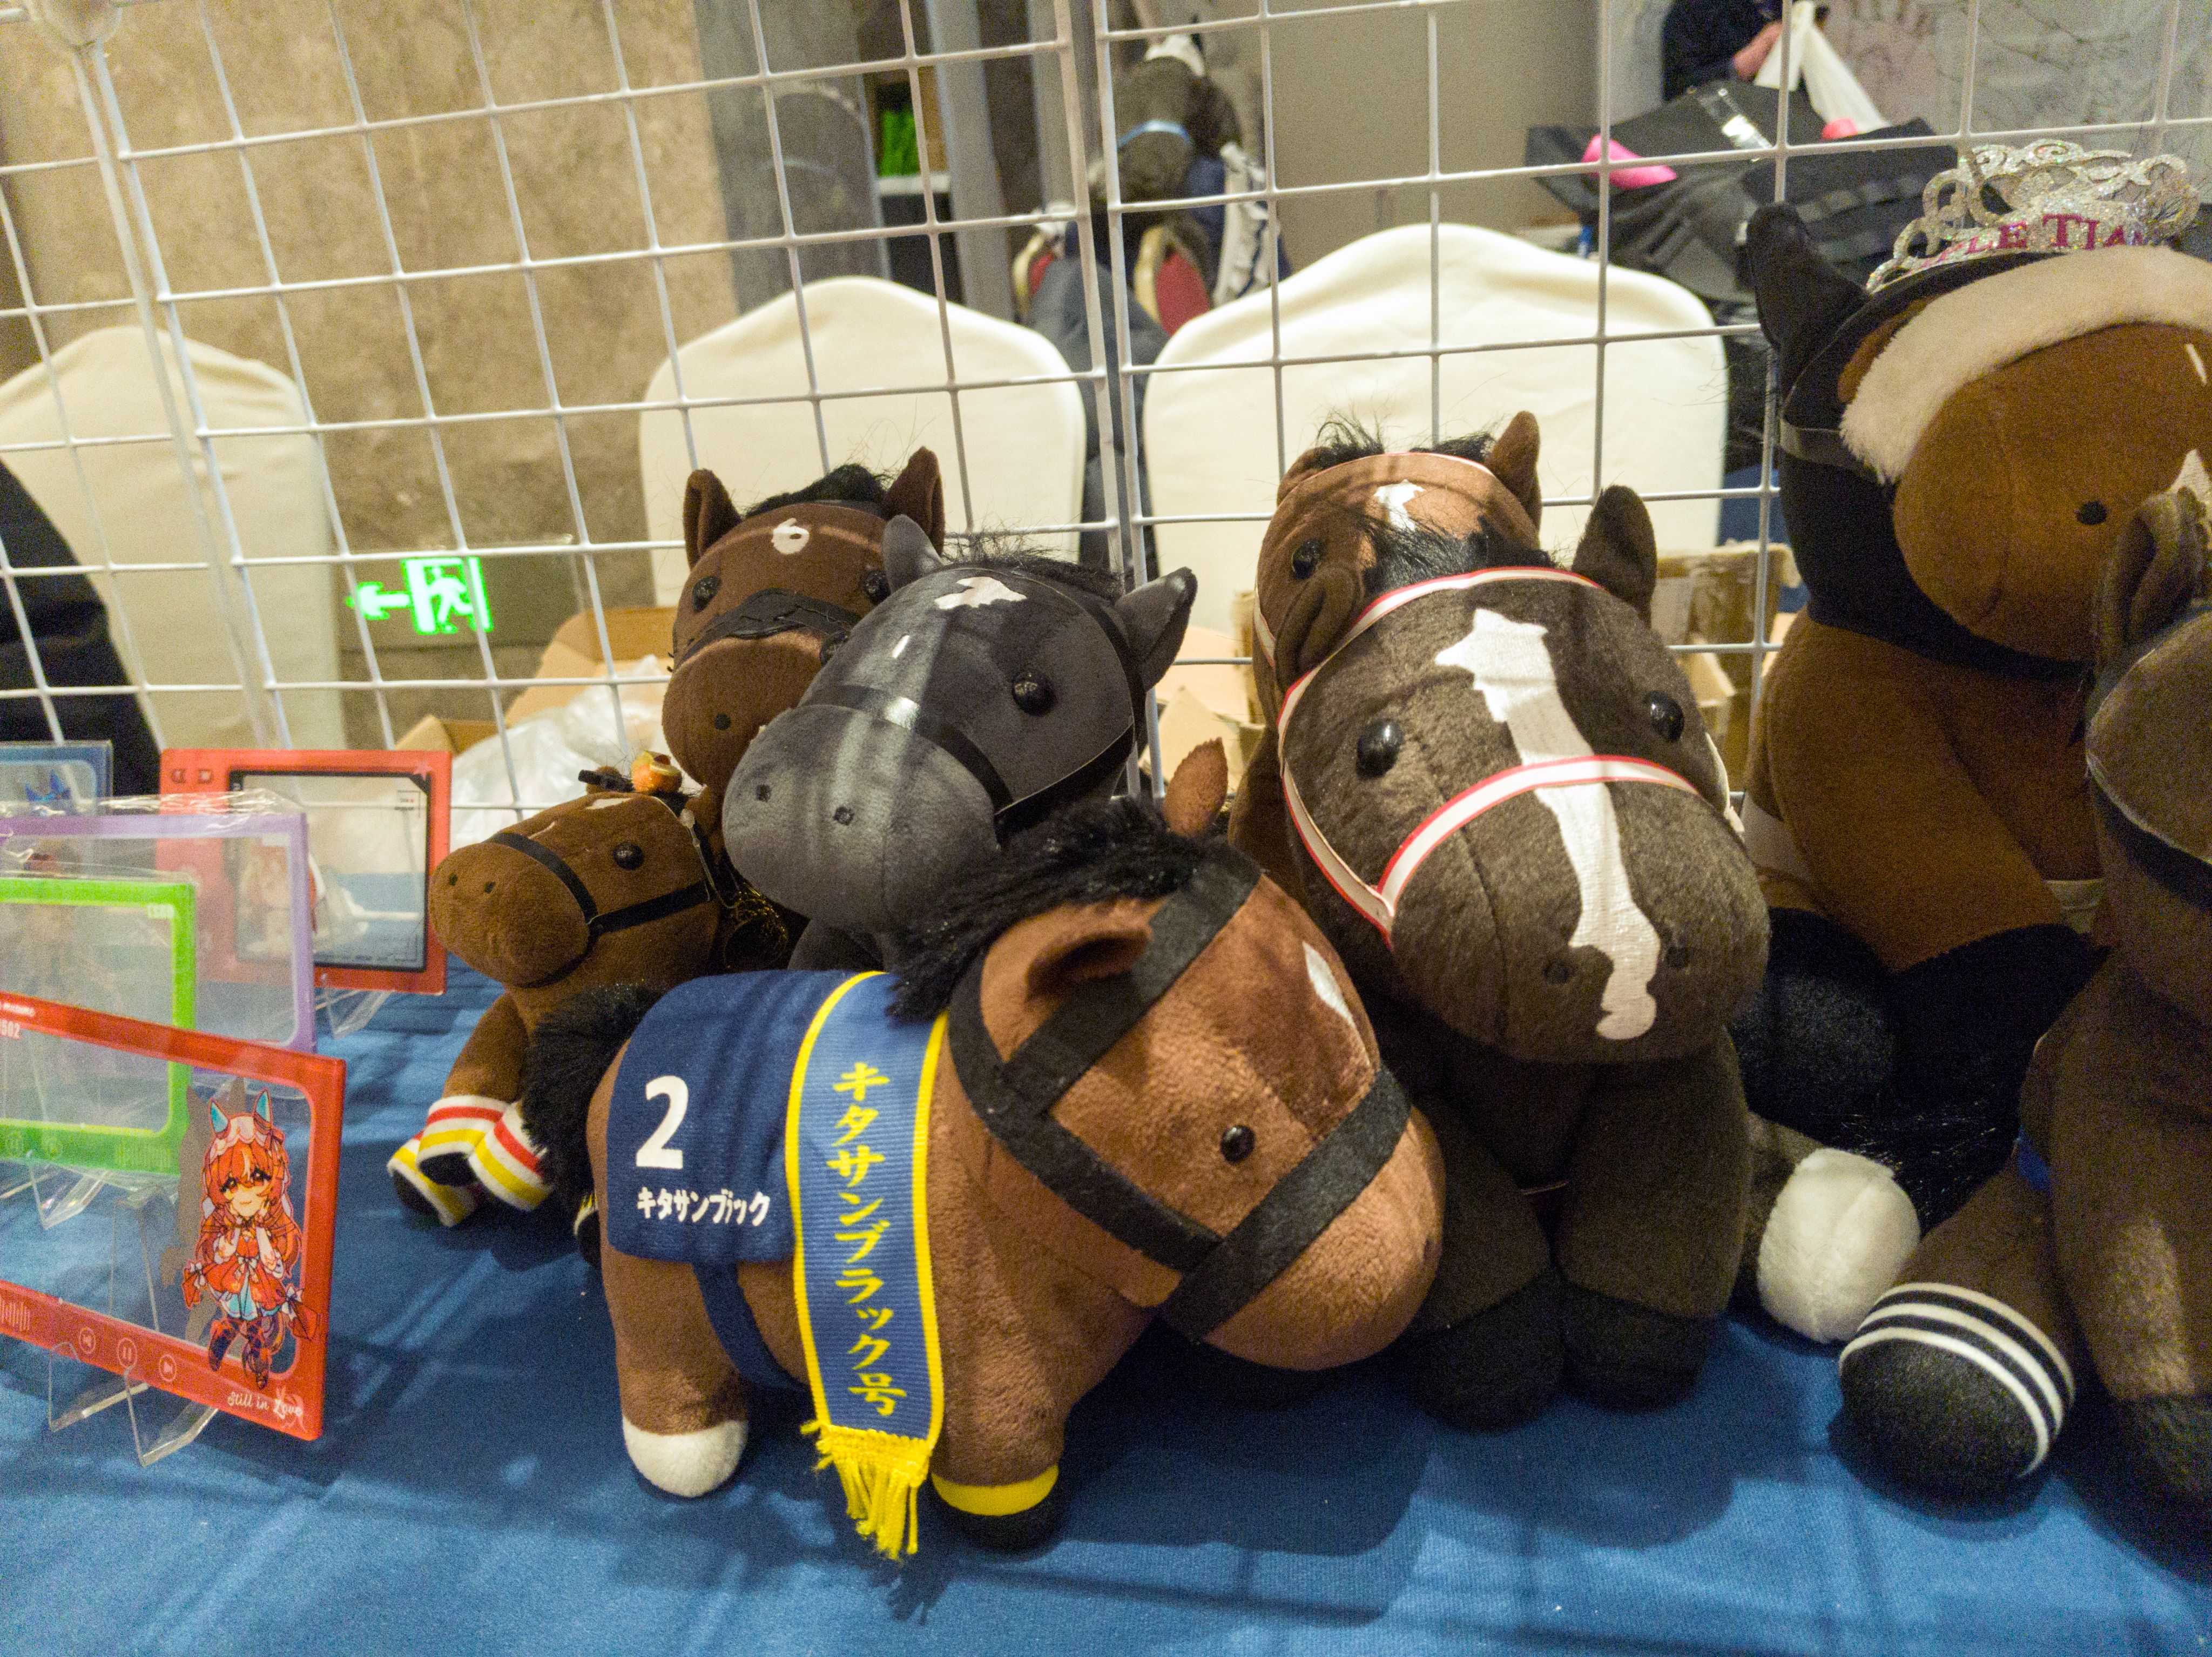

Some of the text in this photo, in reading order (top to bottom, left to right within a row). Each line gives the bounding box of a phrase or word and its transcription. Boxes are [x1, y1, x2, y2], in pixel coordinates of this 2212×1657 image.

[636, 1075, 689, 1169] 2
[827, 1062, 907, 1417] キタサンブラック号
[256, 1395, 269, 1410] in
[273, 1399, 304, 1419] Love
